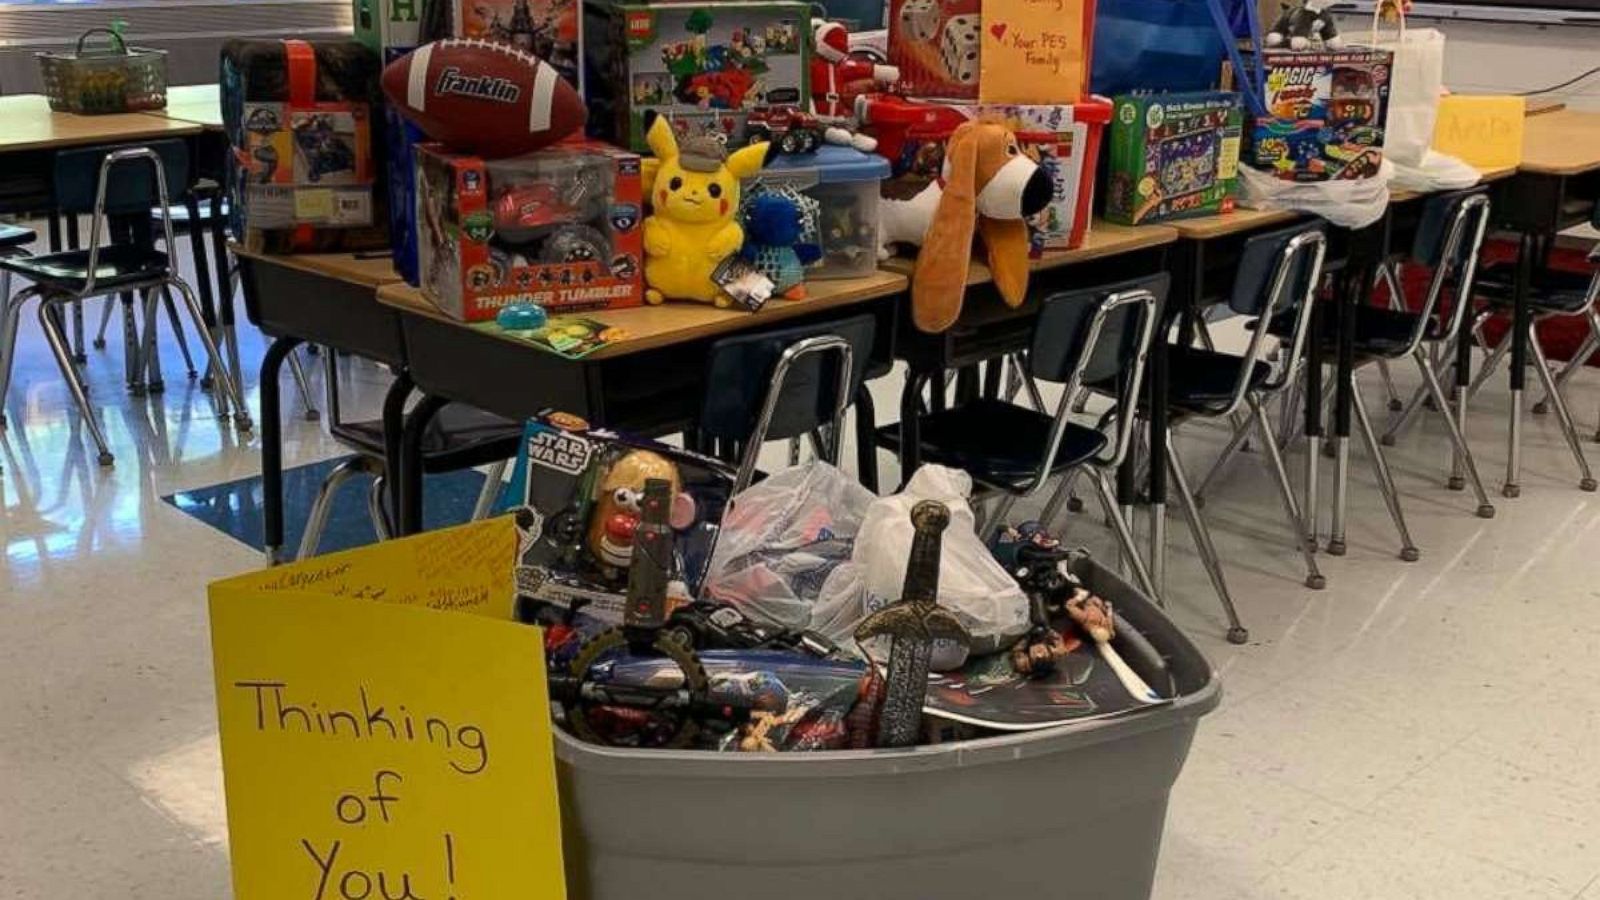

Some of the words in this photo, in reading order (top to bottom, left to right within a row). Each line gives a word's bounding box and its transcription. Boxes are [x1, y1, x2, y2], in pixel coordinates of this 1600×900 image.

[1012, 32, 1037, 49] Your
[1025, 51, 1060, 74] Family
[435, 66, 520, 104] Franklin
[476, 291, 554, 309] THUNDER
[559, 285, 633, 302] TUMBLER
[528, 444, 583, 469] WARS
[529, 432, 586, 456] STAR
[234, 678, 488, 774] Thinking
[336, 771, 402, 824] of
[302, 833, 456, 900] You!
